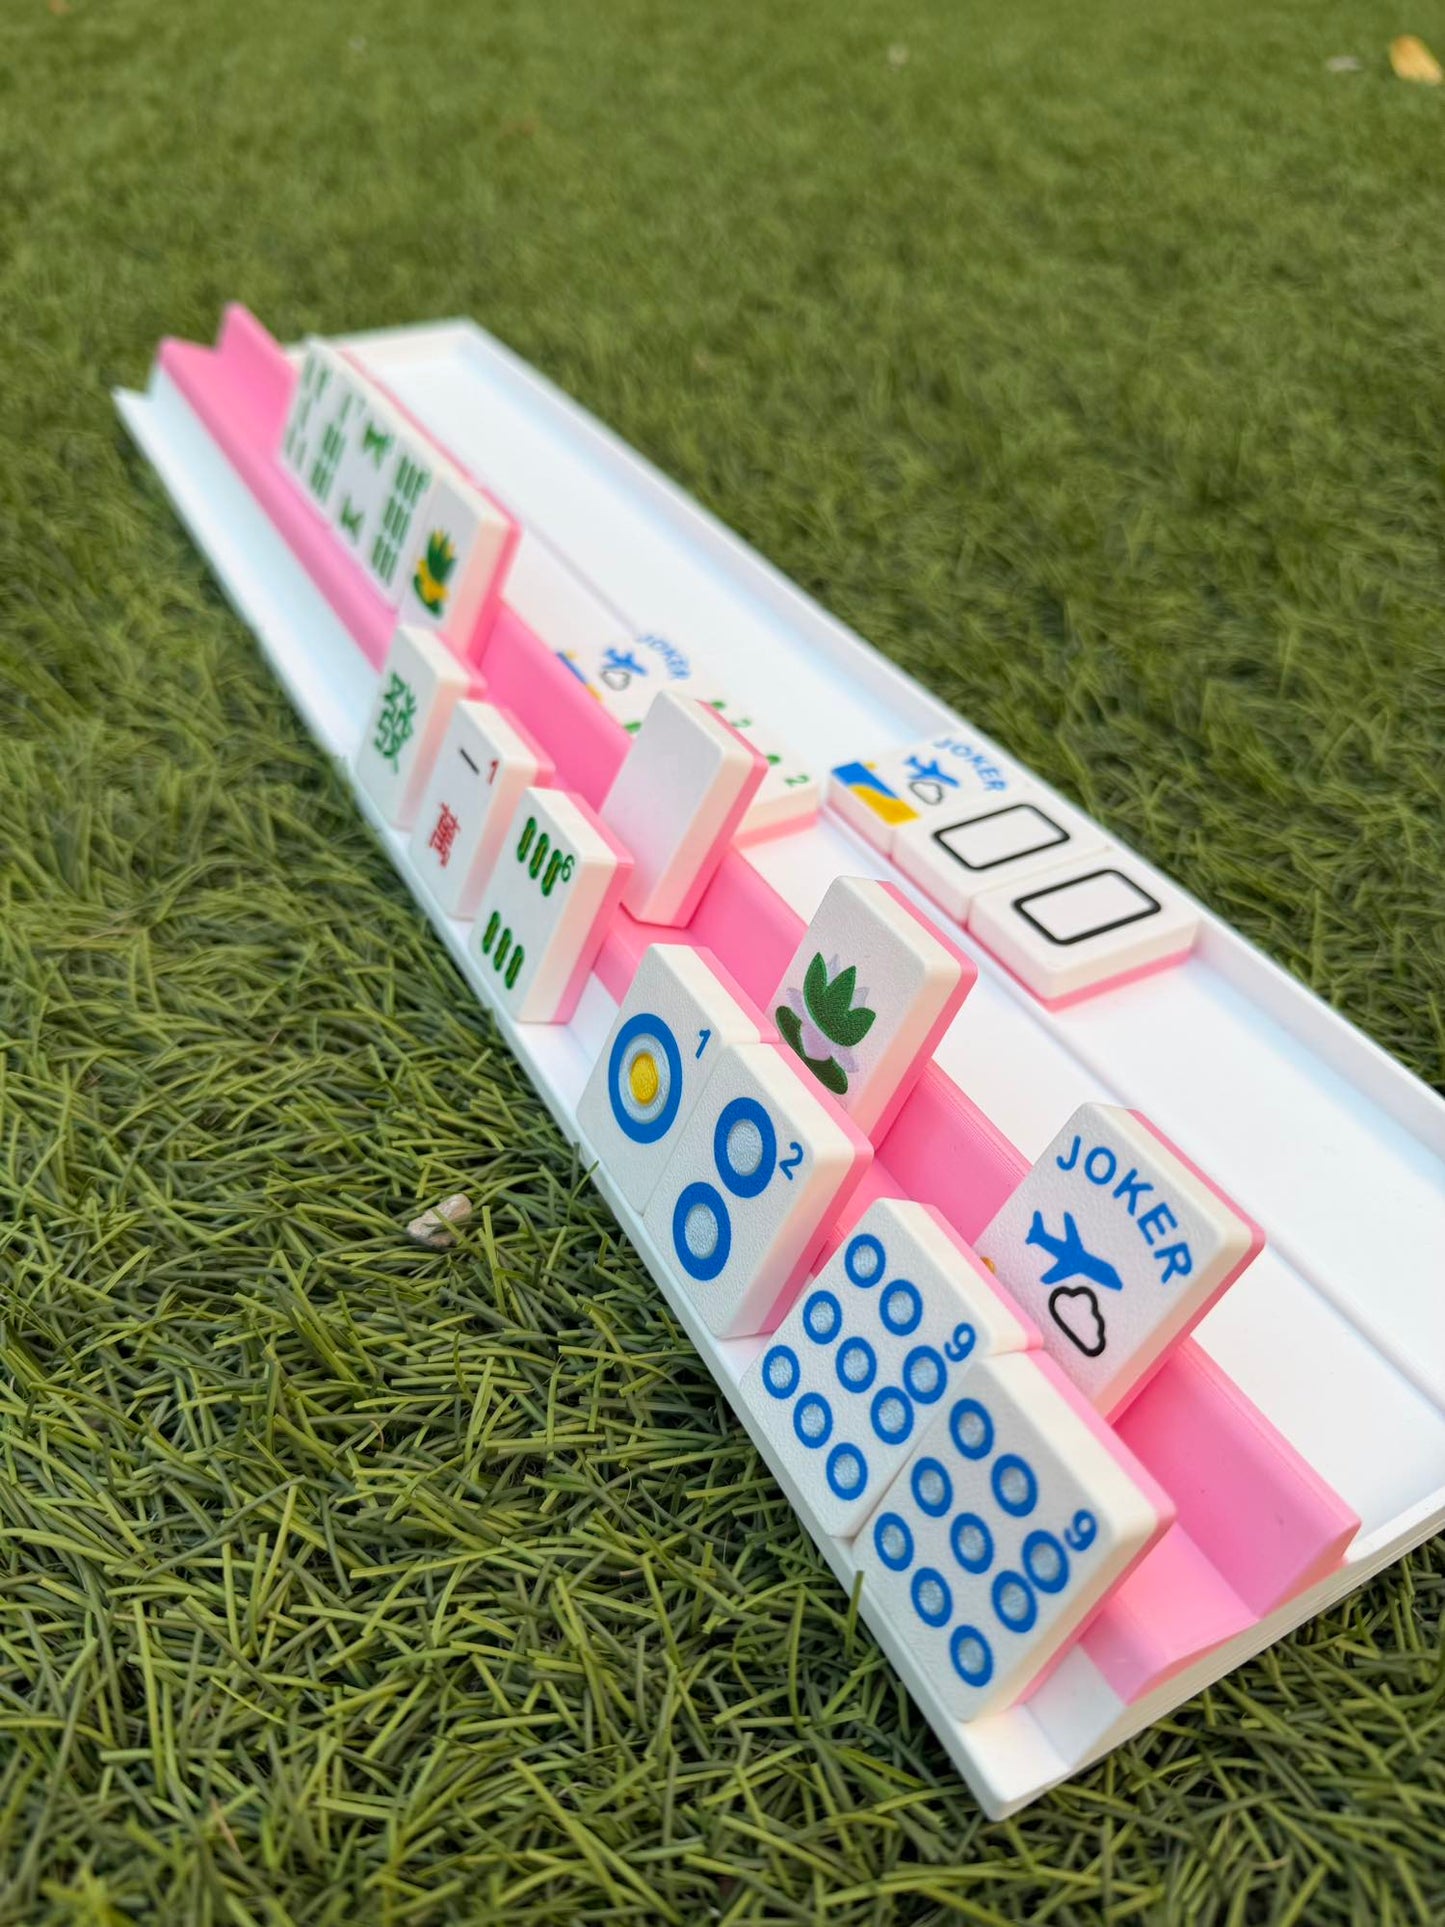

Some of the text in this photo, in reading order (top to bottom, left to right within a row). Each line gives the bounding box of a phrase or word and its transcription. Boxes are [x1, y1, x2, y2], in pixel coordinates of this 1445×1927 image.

[636, 633, 690, 679] JOKER
[487, 759, 499, 785] 1
[784, 774, 809, 787] 2
[934, 737, 1008, 792] JOKER
[561, 854, 576, 882] 6
[695, 1029, 711, 1059] 1
[779, 1142, 804, 1180] 2
[1056, 1135, 1193, 1284] JOKER
[944, 1321, 977, 1363] 9
[1063, 1509, 1098, 1552] 9
